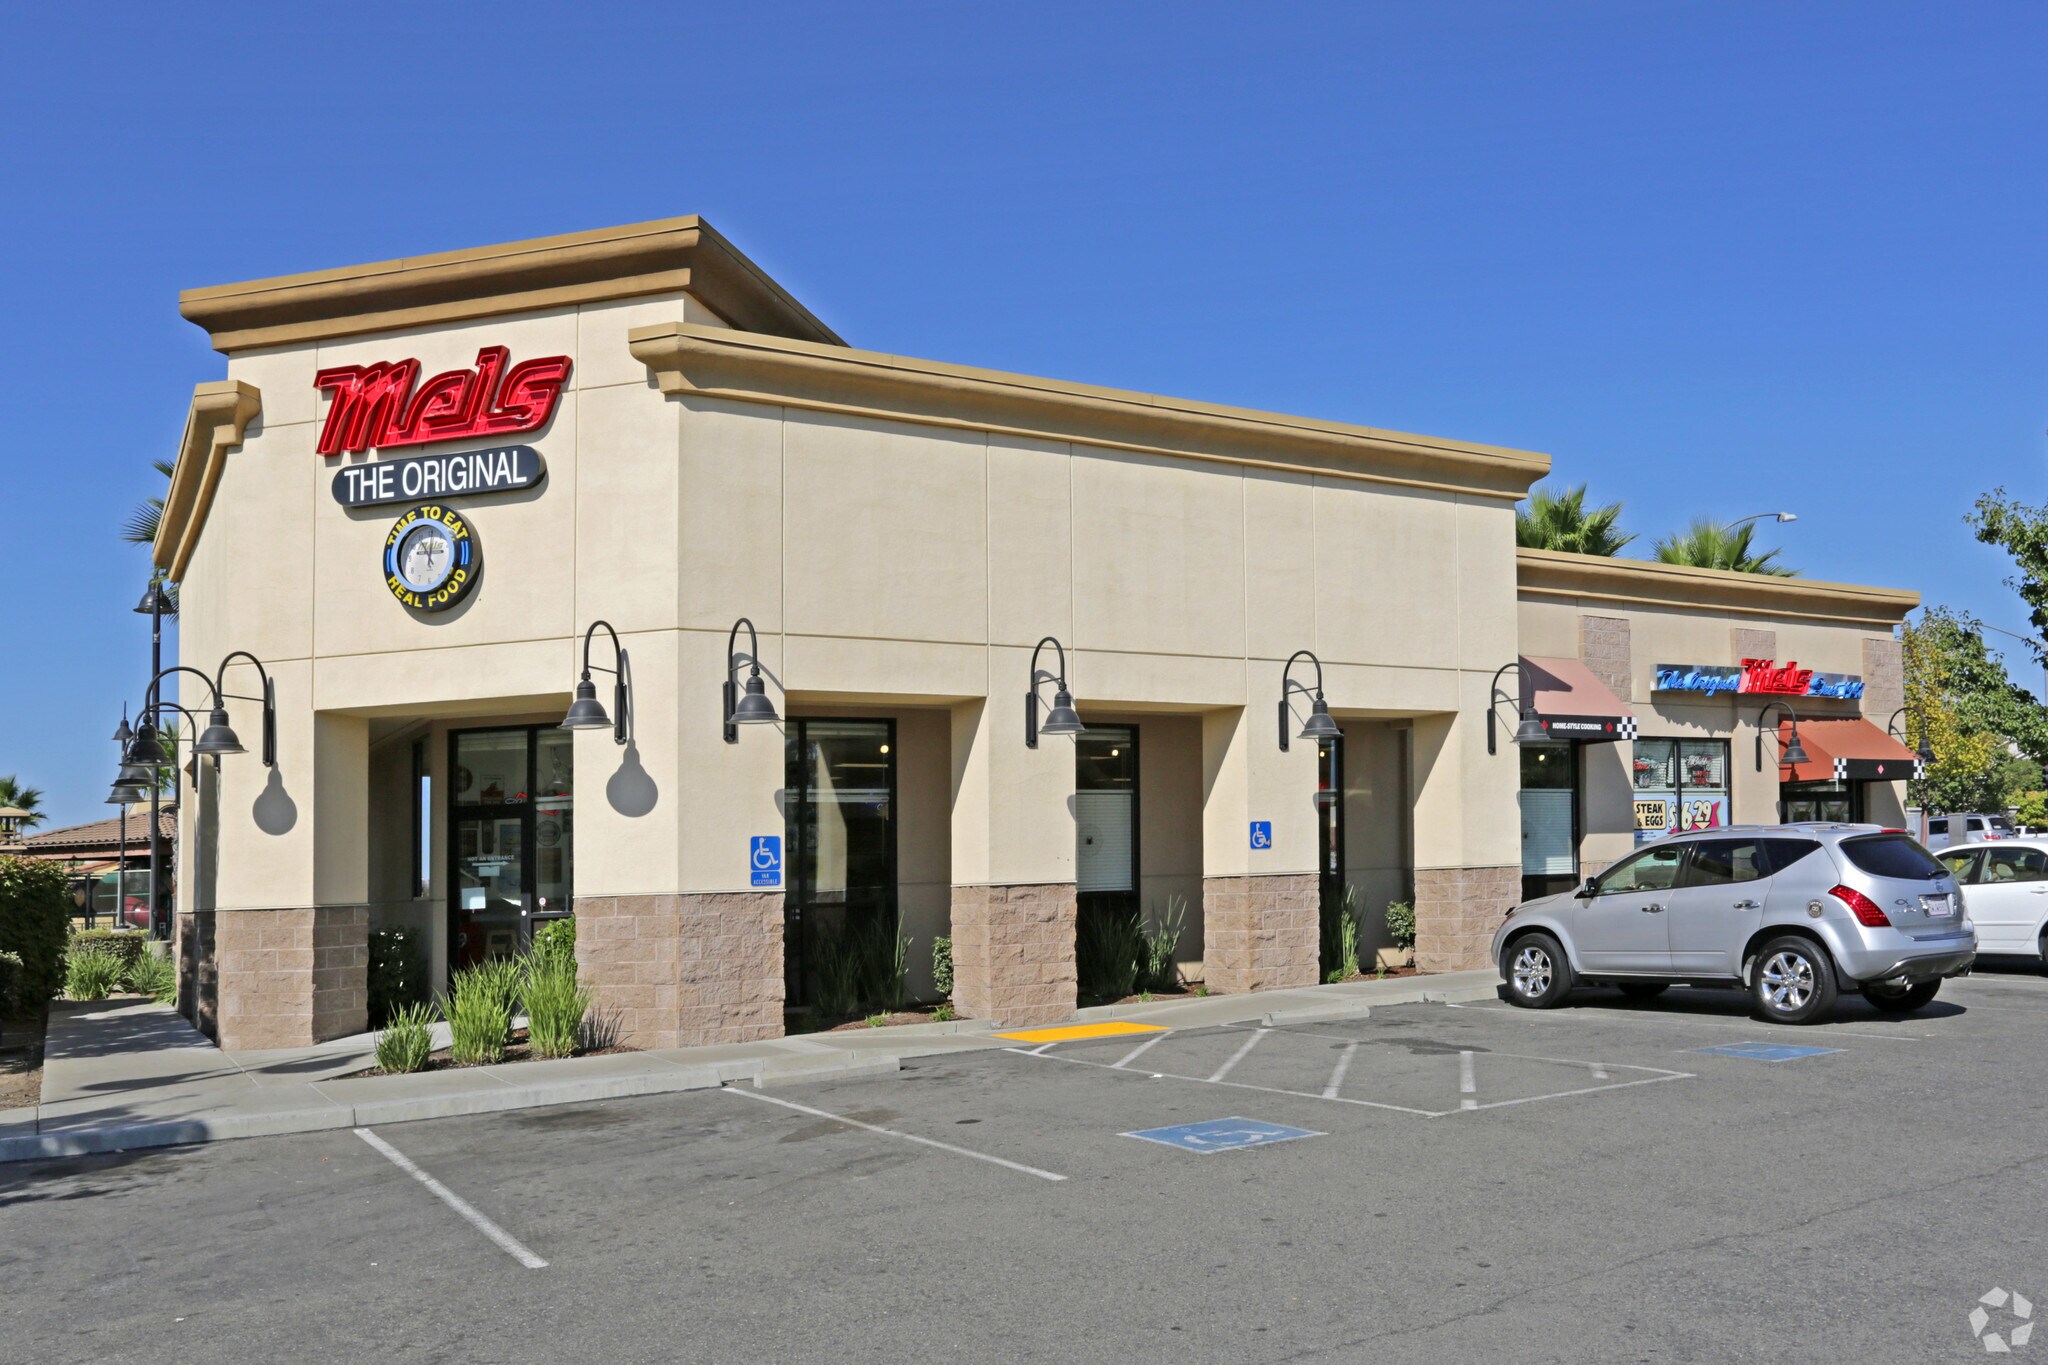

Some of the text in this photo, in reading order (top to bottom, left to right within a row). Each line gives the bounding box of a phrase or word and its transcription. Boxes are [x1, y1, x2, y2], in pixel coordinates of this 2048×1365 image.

[313, 345, 573, 457] Mels
[344, 450, 527, 502] THE ORIGINAL
[387, 506, 468, 545] TIME TO EAT
[388, 569, 466, 607] REAL FOOD
[1741, 658, 1813, 694] Mels
[1552, 722, 1580, 730] HOME-STYLE
[1636, 803, 1663, 814] STEAK
[1645, 815, 1664, 826] EGGS
